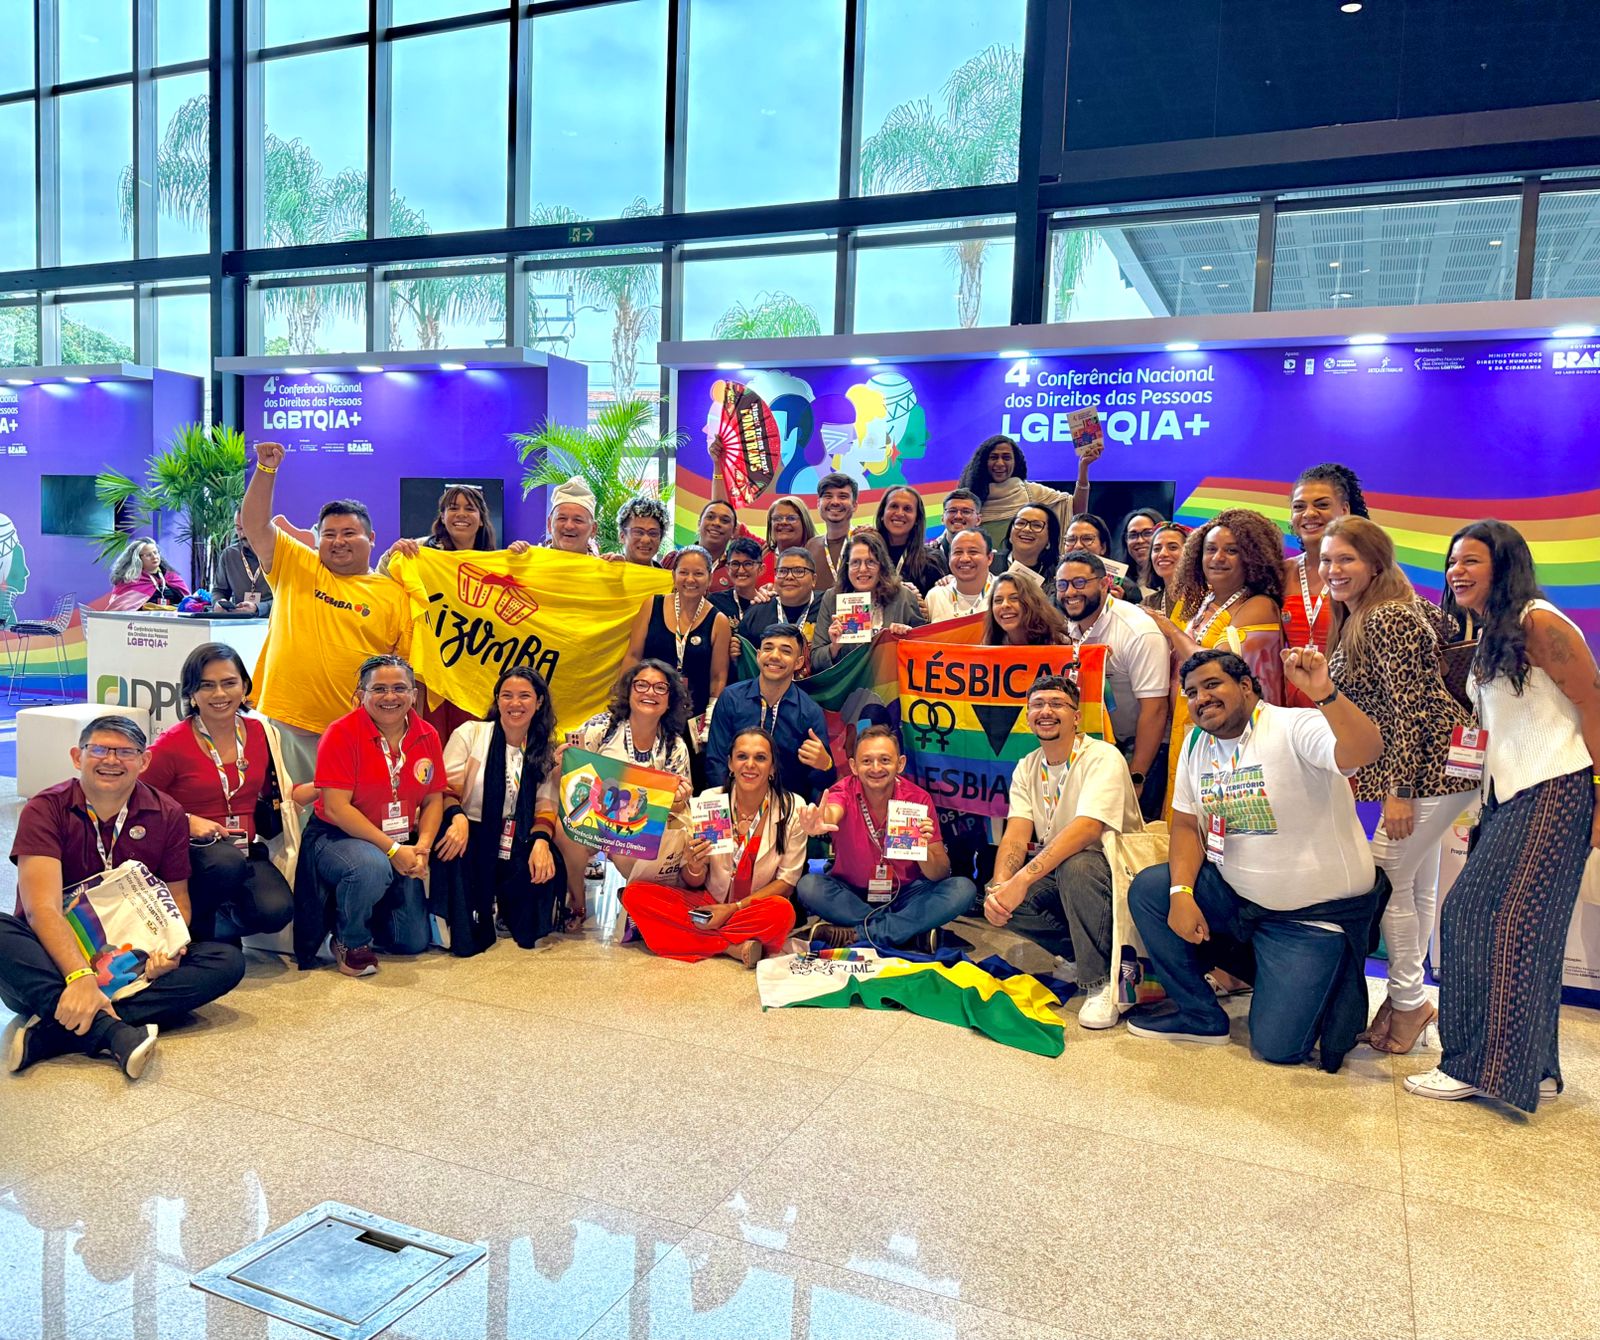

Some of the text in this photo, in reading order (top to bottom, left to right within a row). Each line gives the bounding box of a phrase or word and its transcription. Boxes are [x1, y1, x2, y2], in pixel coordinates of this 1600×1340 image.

[1037, 368, 1133, 390] Conferência
[1136, 365, 1215, 384] Nacional
[280, 383, 324, 396] Conferência
[326, 382, 362, 393] Nacional
[264, 397, 362, 408] dos Direitos das Pessoas
[1004, 388, 1213, 409] dos Direitos das Pessoas
[263, 410, 362, 431] LGBTQIA+
[127, 637, 168, 648] LGBTQIA+
[568, 824, 594, 840] Conferência
[594, 834, 614, 846] Nacional
[626, 842, 646, 852] Direitos
[584, 839, 602, 850] Pessoas
